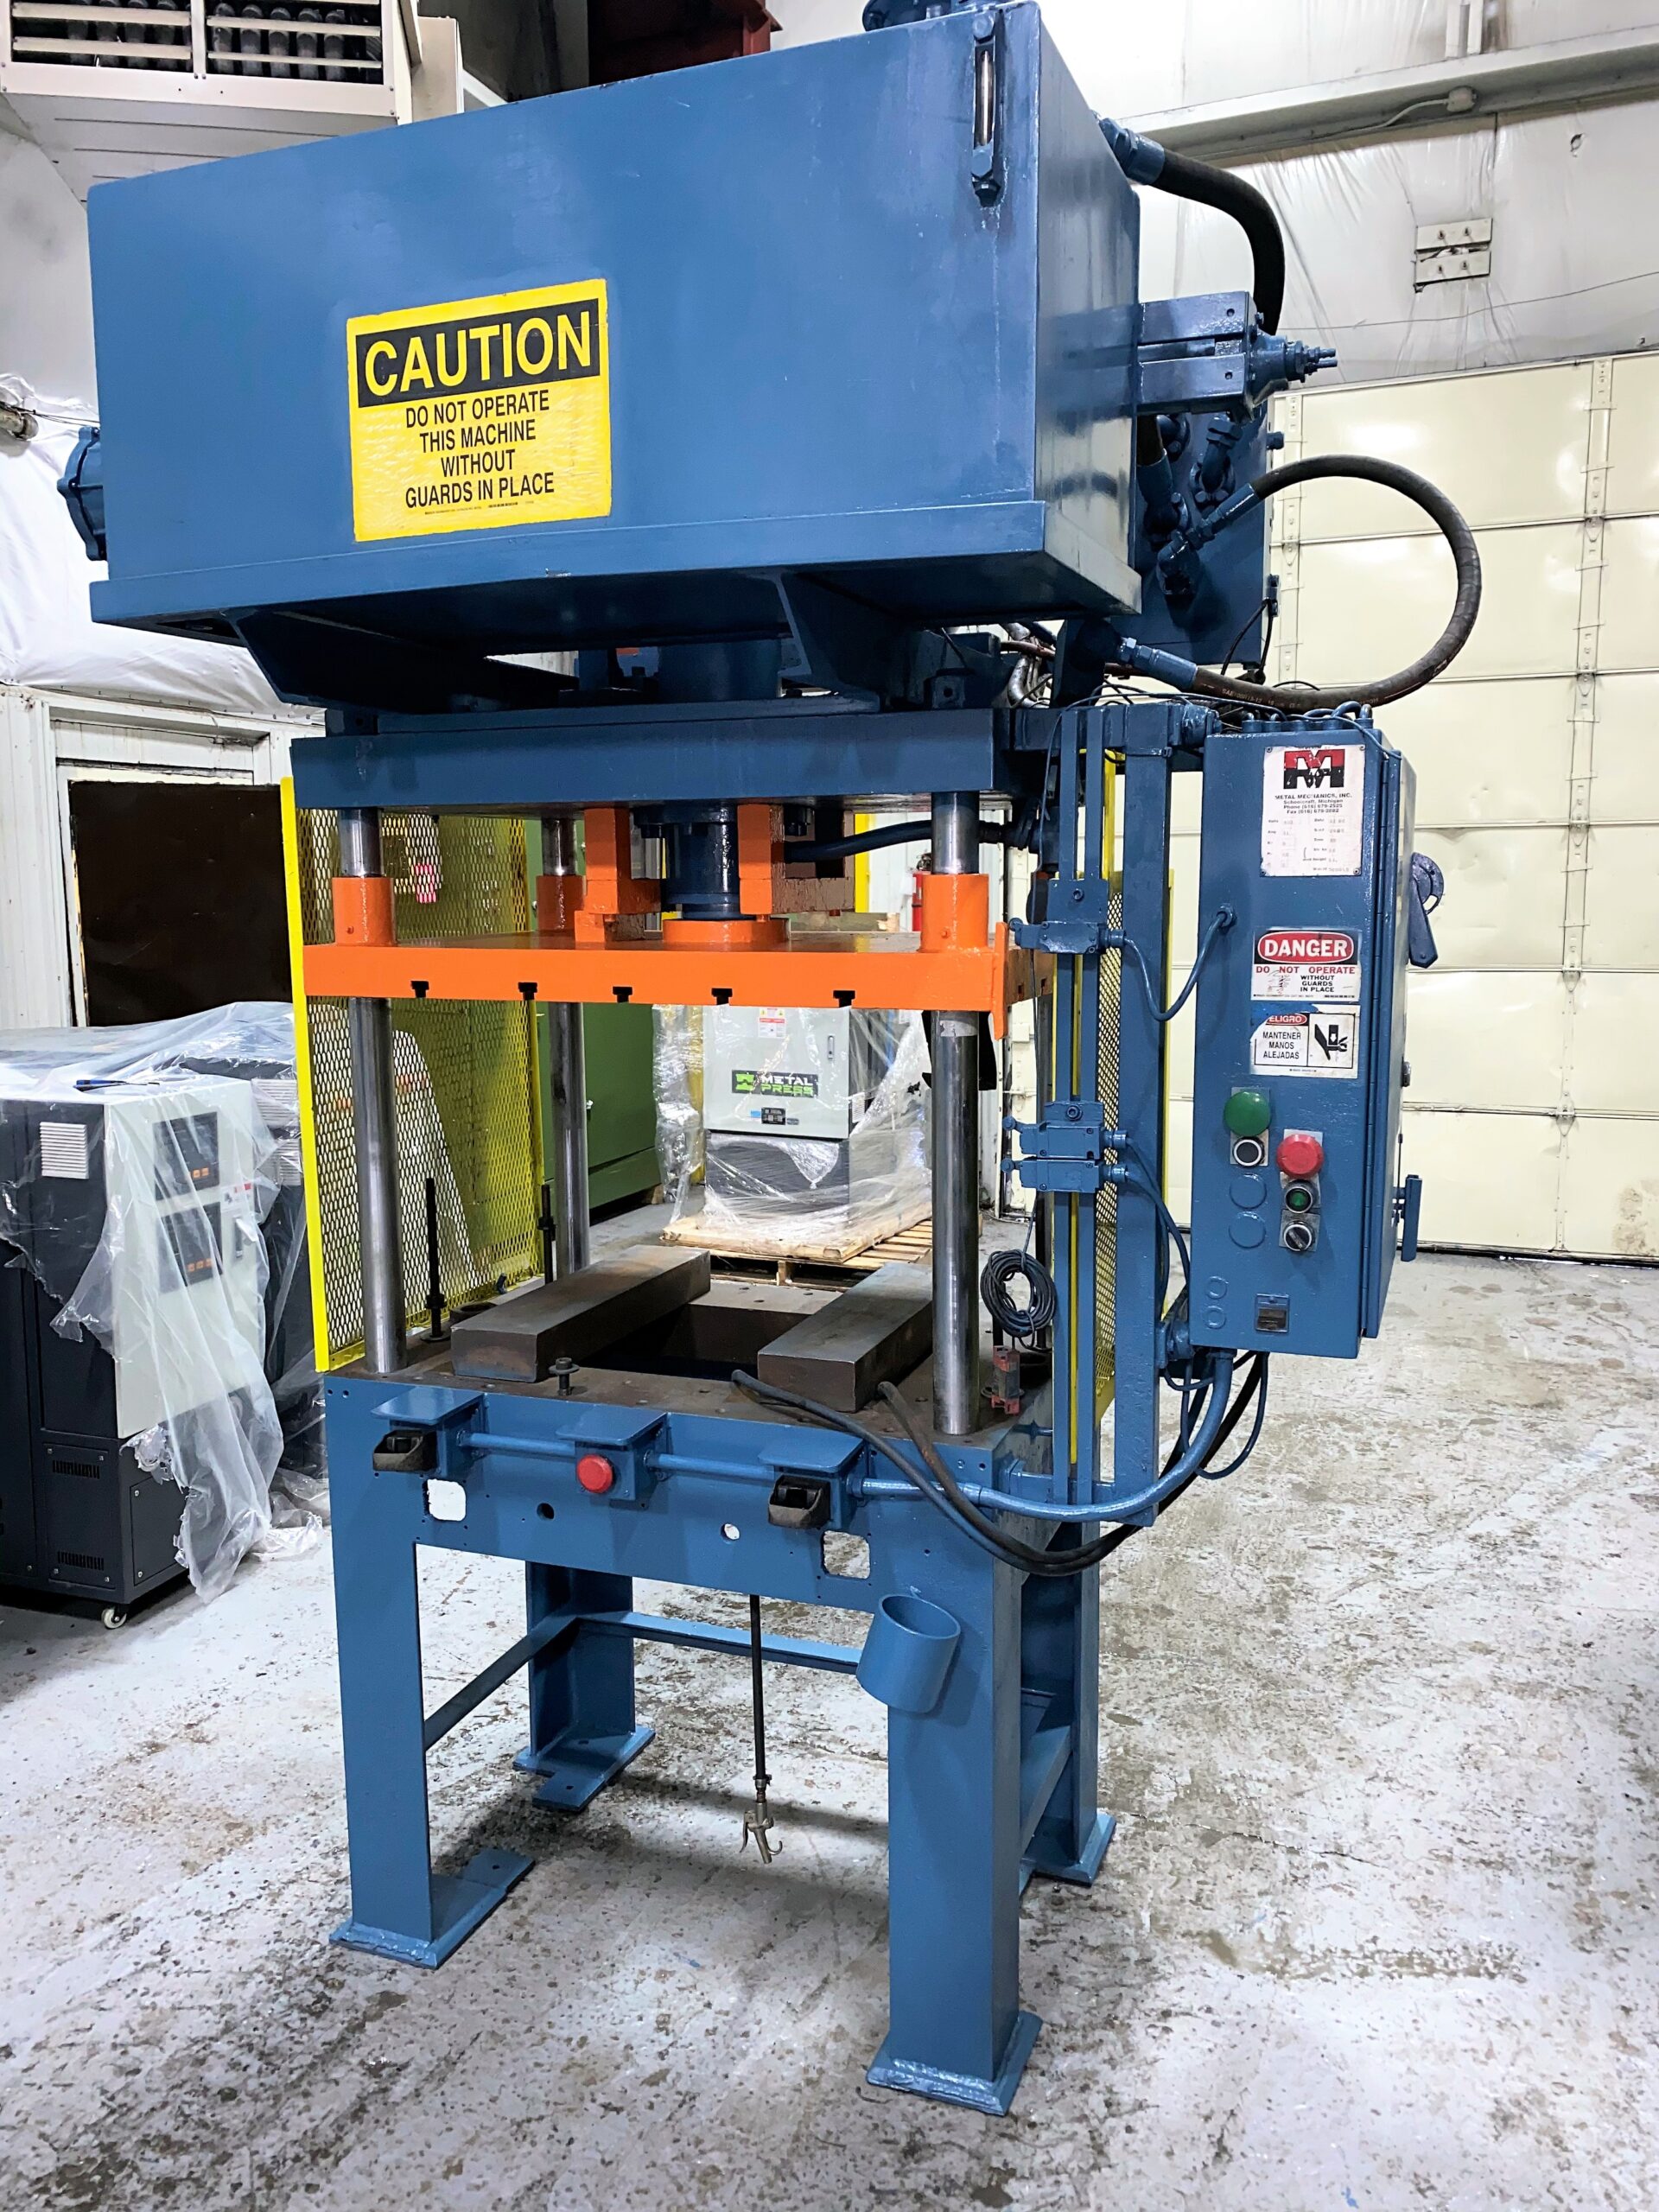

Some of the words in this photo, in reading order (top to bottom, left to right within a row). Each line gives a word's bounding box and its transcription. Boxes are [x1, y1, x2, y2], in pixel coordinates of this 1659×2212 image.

[365, 311, 591, 397] CAUTION
[406, 405, 429, 428] DO
[434, 400, 467, 424] NOT
[472, 389, 550, 419] OPERATE
[419, 429, 455, 453] THIS
[461, 419, 536, 448] MACHINE
[441, 448, 516, 477] WITHOUT
[405, 481, 473, 508] GUARDS
[478, 479, 493, 499] IN
[499, 472, 555, 498] PLACE
[1264, 939, 1348, 957] DANGER
[1308, 966, 1356, 975] OPERATE
[1268, 1014, 1302, 1023] ELIGRO
[1262, 1051, 1300, 1059] ALEJADAS
[760, 1074, 814, 1086] METAL
[760, 1084, 814, 1096] PRESS
